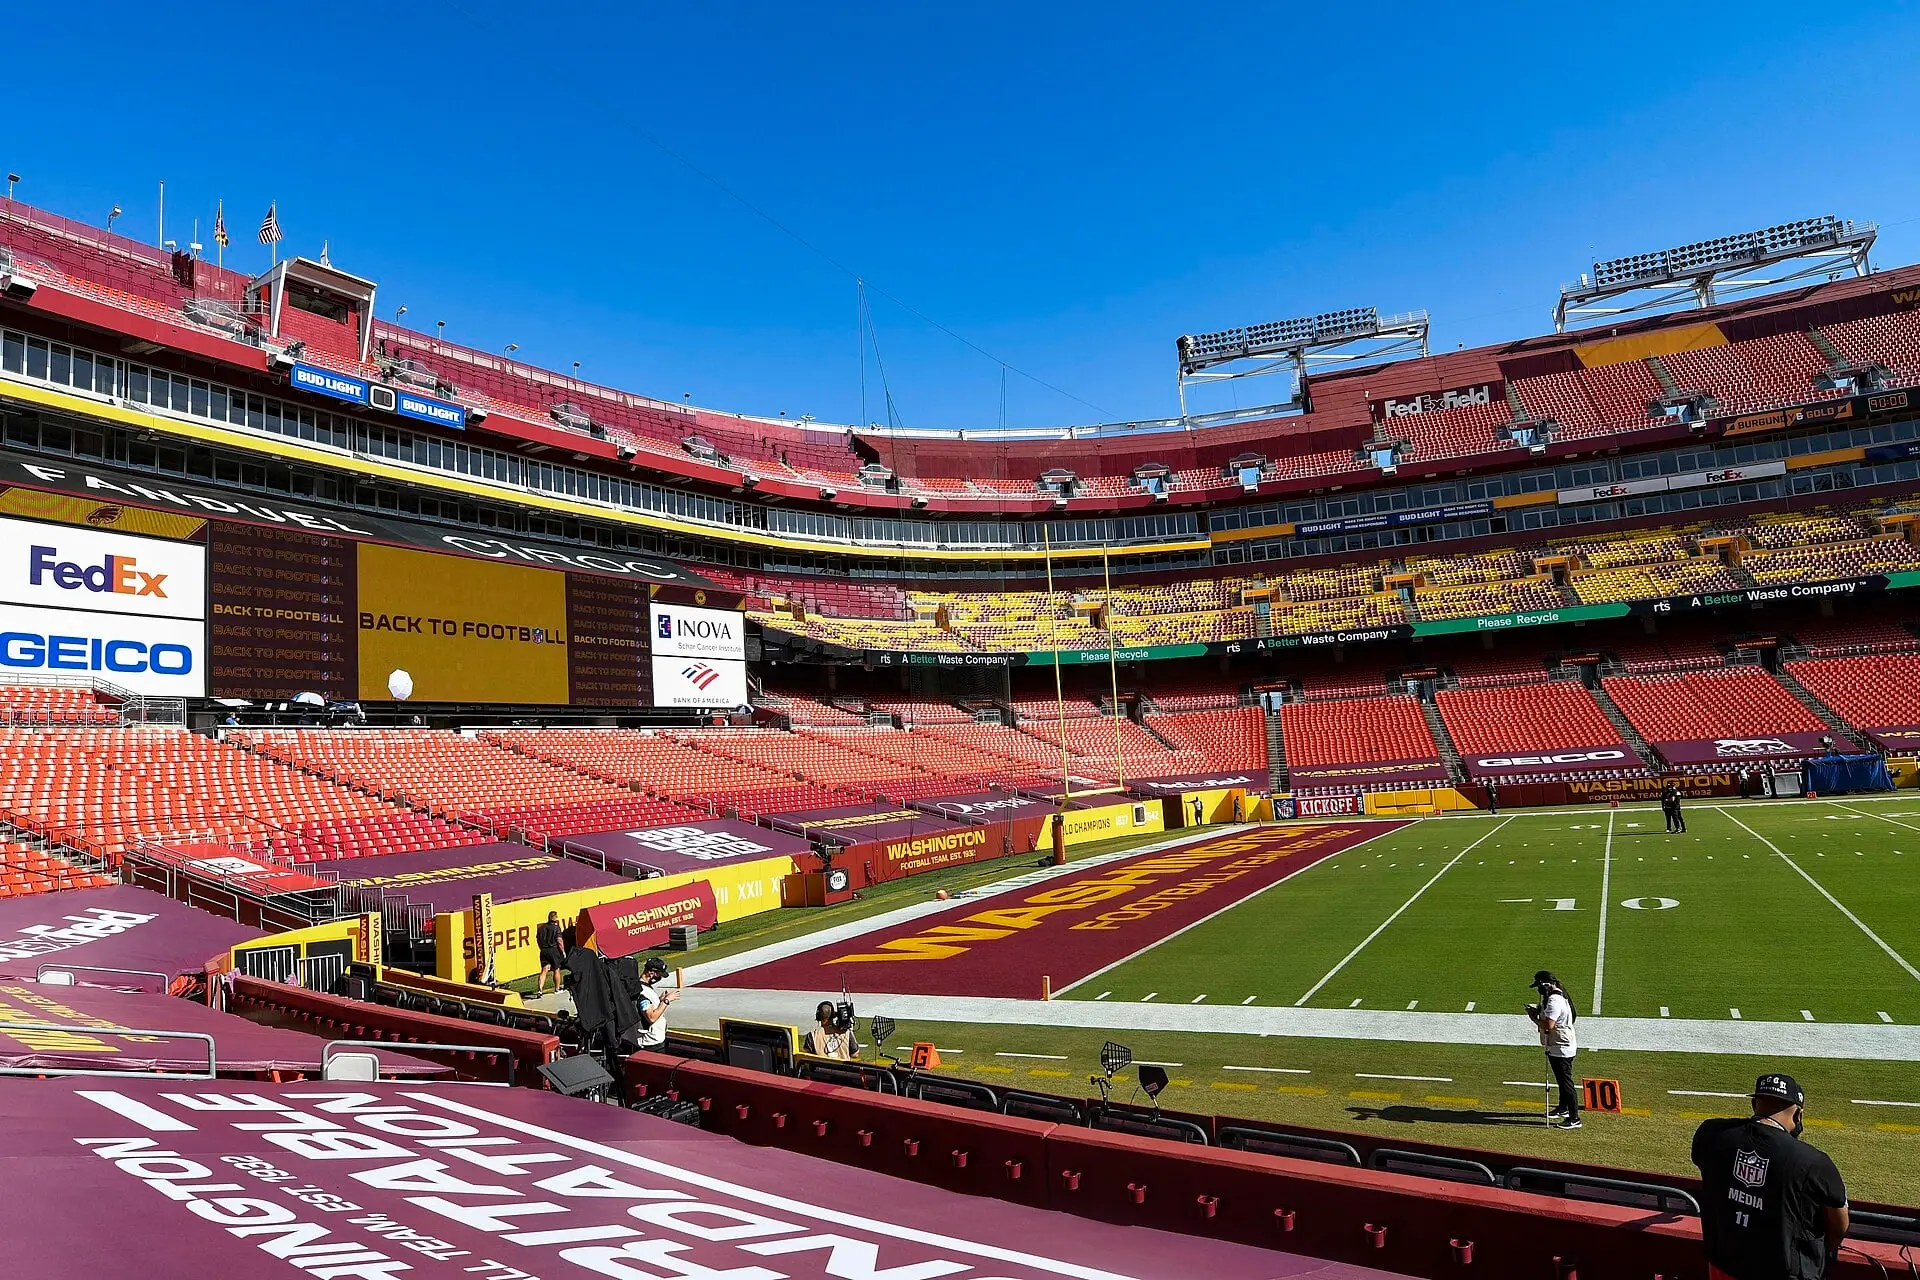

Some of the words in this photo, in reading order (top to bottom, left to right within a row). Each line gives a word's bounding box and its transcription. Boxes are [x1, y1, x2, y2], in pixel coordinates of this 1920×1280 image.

[298, 370, 324, 386] BUD
[326, 378, 362, 397] LIGHT
[403, 400, 428, 414] BUD
[428, 406, 460, 422] LIGHT
[1738, 414, 1796, 430] BURGUNDY
[1796, 412, 1804, 420] &
[1807, 408, 1834, 418] GOLD
[1706, 470, 1743, 483] FedEx
[20, 462, 374, 536] FANDUEL
[1592, 486, 1628, 498] FedEx
[1400, 513, 1416, 521] BUD
[1417, 510, 1441, 519] LIGHT
[1302, 524, 1318, 533] BUD
[1319, 522, 1342, 531] LIGHT
[276, 530, 344, 548] FOOTBLL
[276, 550, 344, 568] FOOTBLL
[30, 545, 168, 598] FedEx
[276, 570, 344, 586] FOOTBLL
[276, 590, 344, 605] FOOTBLL
[1691, 597, 1700, 606] A
[1704, 592, 1744, 606] Better
[1746, 586, 1788, 602] Waste
[1792, 580, 1856, 596] Company
[214, 604, 252, 616] BACK
[254, 607, 273, 618] TO
[276, 610, 344, 623] FOOTBLL
[1654, 600, 1670, 612] rts
[360, 612, 422, 634] BACK
[428, 618, 457, 636] TO
[463, 622, 566, 644] FOOTBLL
[678, 619, 732, 640] INOVA
[1478, 616, 1512, 628] Please
[1517, 612, 1560, 624] Recycle
[276, 629, 344, 644] FOOTBLL
[610, 638, 649, 648] FOOTBLL
[1257, 640, 1266, 649] A
[1268, 636, 1300, 648] Better
[1302, 632, 1335, 645] Waste
[1338, 628, 1389, 642] Company
[0, 632, 192, 675] GEICO
[276, 649, 344, 662] FOOTBLL
[696, 643, 718, 652] Cancer
[1081, 652, 1110, 661] Please
[1114, 649, 1148, 661] Recycle
[1226, 642, 1240, 653] rts
[880, 653, 891, 664] rts
[902, 655, 908, 663] A
[911, 654, 936, 664] Better
[938, 655, 963, 664] Waste
[966, 655, 1008, 666] Company
[276, 669, 344, 681] FOOTBLL
[1478, 750, 1625, 767] GEICO
[1293, 762, 1440, 776] WASHINGTON
[1569, 774, 1731, 793] WASHINGTON
[1589, 792, 1635, 801] FOOTBALL
[1300, 798, 1353, 815] KICKOFF
[624, 826, 707, 842] BUD
[1075, 818, 1110, 833] CHAMPIONS
[638, 832, 747, 851] LIGHT
[676, 840, 774, 860] SELTZER
[887, 830, 986, 861] WASHINGTON
[341, 855, 560, 887] WASHINGTON
[900, 860, 931, 871] FOOTBALL
[932, 856, 950, 866] TEAM,
[950, 852, 962, 862] EST.
[383, 878, 452, 889] FOOTBALL
[454, 872, 495, 880] TEAM,
[496, 868, 522, 876] EST.
[738, 880, 762, 901] XXII
[820, 824, 1330, 965] WASHINGTON
[1070, 872, 1243, 930] FOOTBALL
[1542, 897, 1680, 911] 10
[614, 896, 702, 929] WASHINGTON
[628, 926, 655, 936] FOOTBALL
[656, 921, 672, 932] TEAM,
[672, 918, 683, 928] EST.
[463, 926, 530, 960] SPER
[914, 1046, 929, 1067] G
[1584, 1080, 1616, 1110] 10
[220, 1155, 298, 1182] 1932
[1738, 1163, 1764, 1182] NFL
[280, 1184, 363, 1212] EST.
[1728, 1188, 1763, 1210] MEDIA
[1736, 1211, 1749, 1227] 11
[347, 1213, 472, 1261] TEAM,
